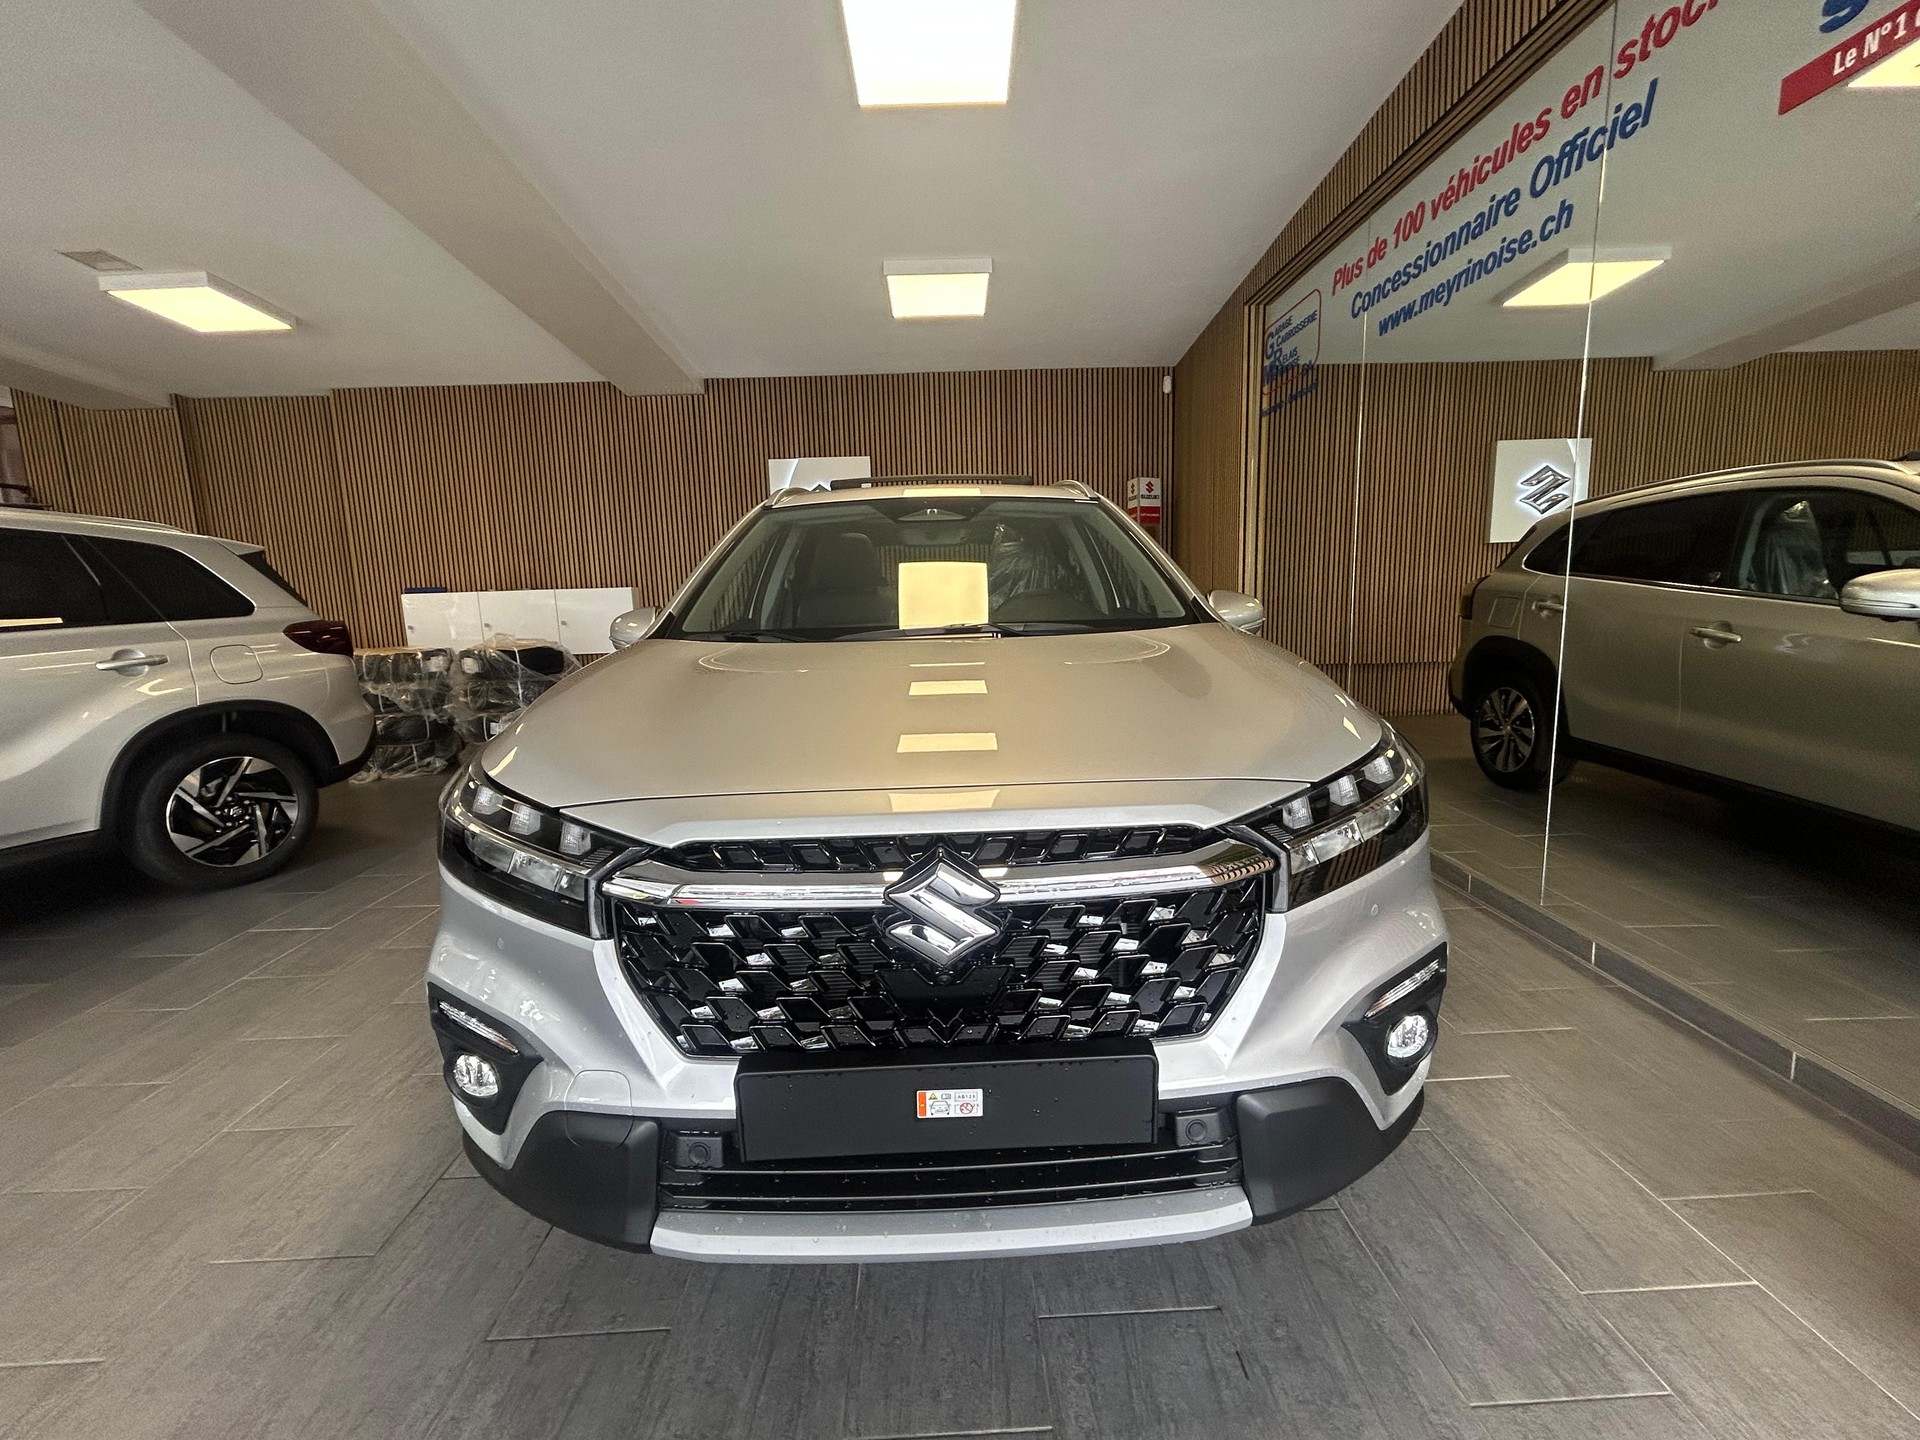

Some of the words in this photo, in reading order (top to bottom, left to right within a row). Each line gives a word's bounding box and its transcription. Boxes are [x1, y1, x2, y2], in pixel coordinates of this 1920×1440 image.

[1833, 47, 1857, 76] Le
[1331, 256, 1364, 296] Plus
[1366, 236, 1388, 269] de
[1393, 201, 1426, 249] 100
[1430, 107, 1553, 221] véhicules
[1560, 65, 1604, 120] en
[1613, 0, 1719, 79] stoc
[1351, 187, 1522, 319] Concessionnaire
[1529, 77, 1659, 199] Officiel
[1276, 309, 1318, 347] CARROSSERIE
[1378, 198, 1574, 337] www.meyrinoise.ch
